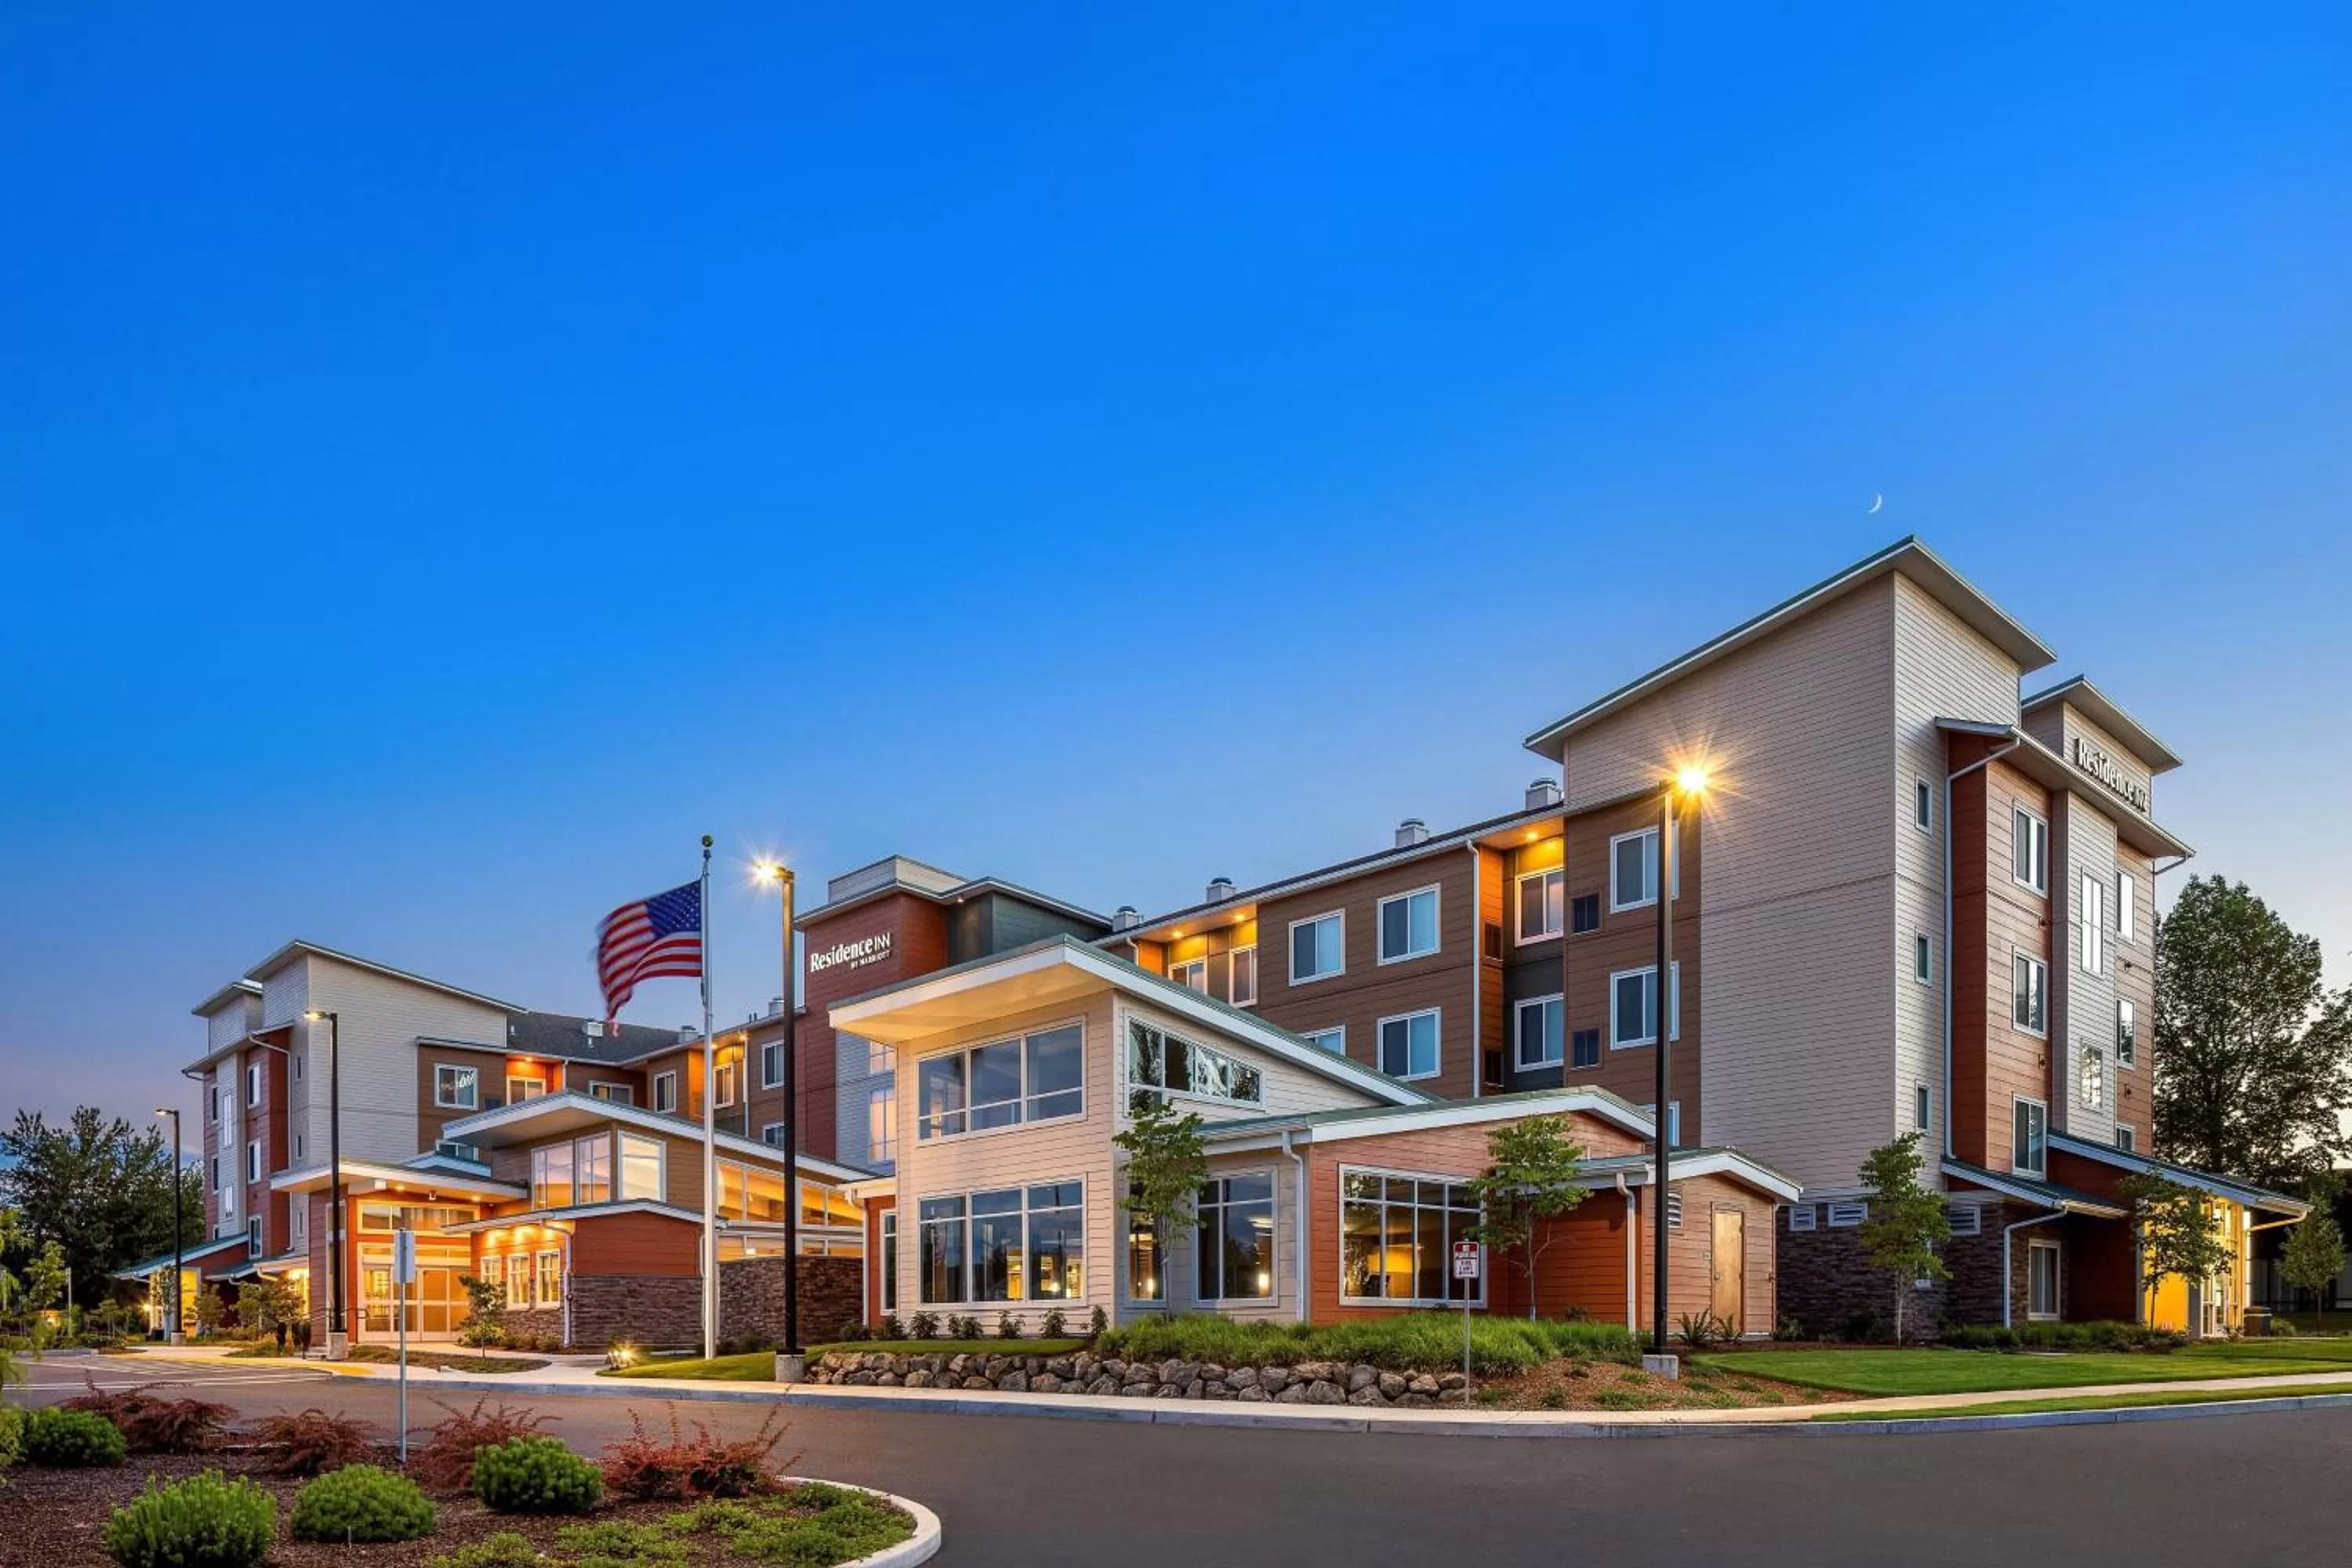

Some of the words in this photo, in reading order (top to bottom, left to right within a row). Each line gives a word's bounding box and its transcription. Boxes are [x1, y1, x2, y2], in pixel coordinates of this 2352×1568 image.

[2078, 738, 2133, 801] Residence
[810, 938, 873, 972] Residence
[873, 931, 891, 951] INN
